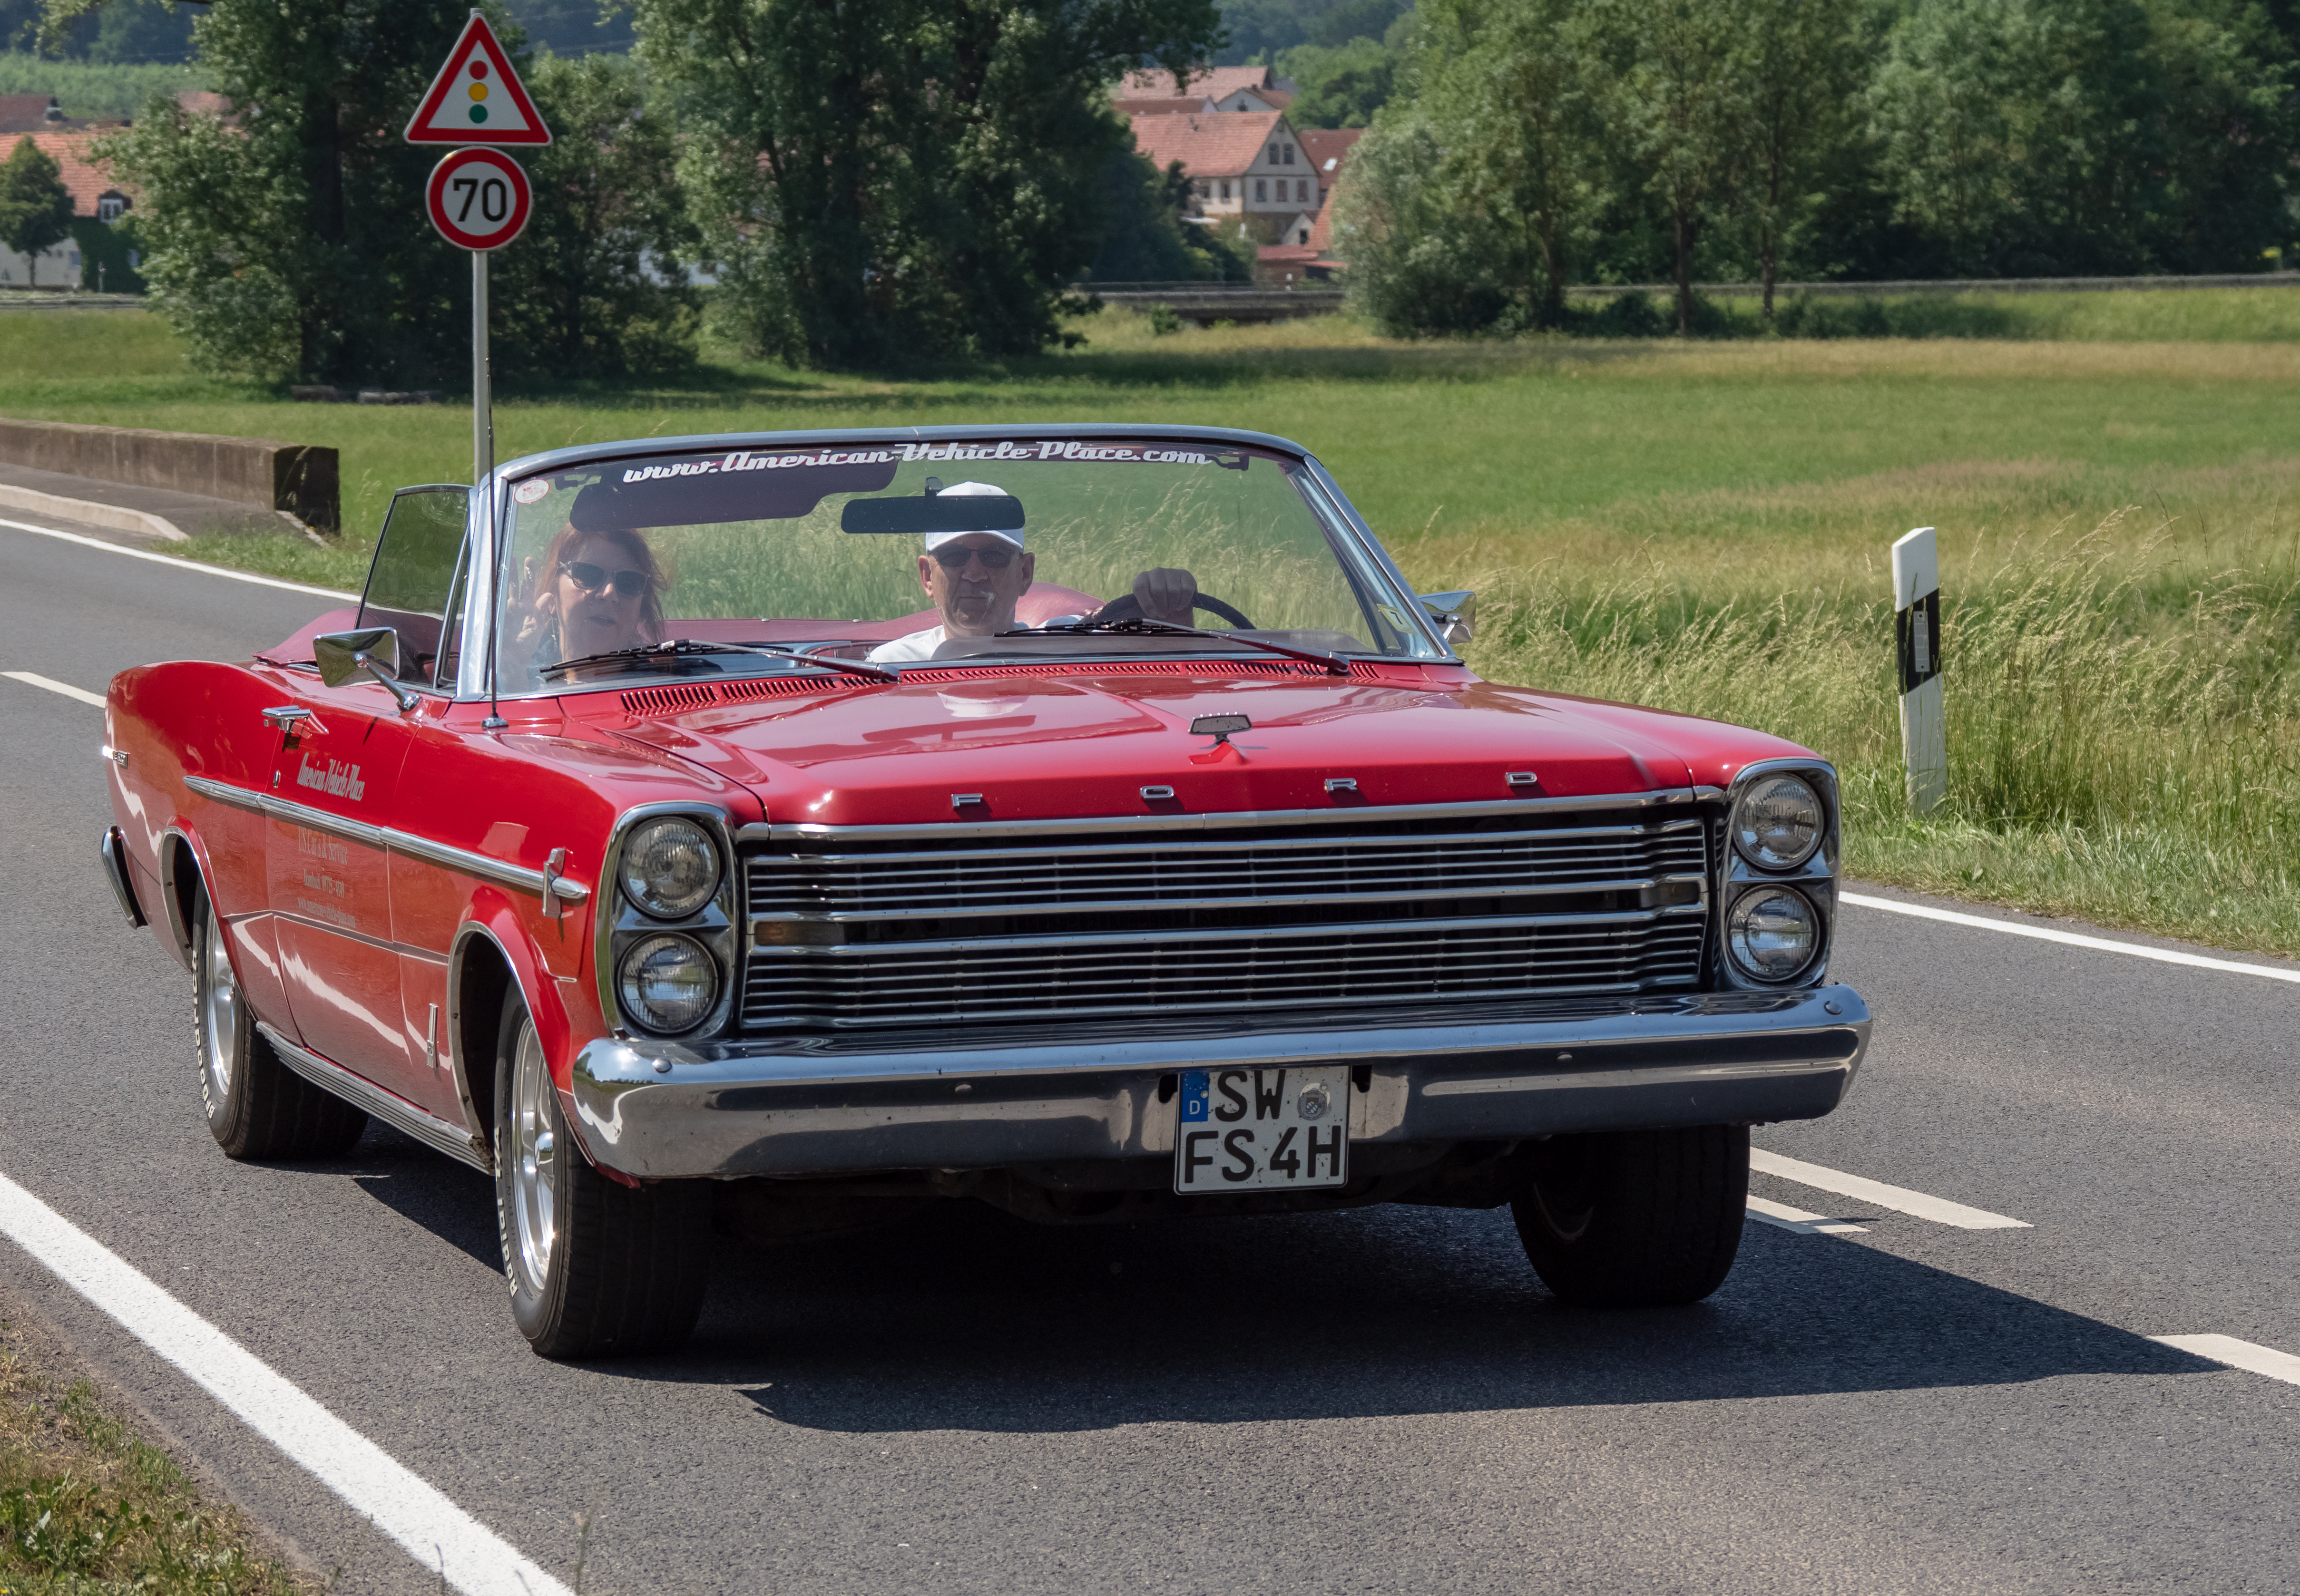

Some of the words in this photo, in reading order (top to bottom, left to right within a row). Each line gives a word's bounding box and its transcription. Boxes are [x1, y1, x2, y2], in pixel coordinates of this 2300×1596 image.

[453, 178, 507, 222] 70
[622, 441, 1213, 483] www.American-Vehicle-Place.com
[297, 752, 326, 791] American
[324, 759, 350, 797] Vehicle
[345, 764, 365, 801] Place
[951, 771, 1537, 807] FORD
[328, 834, 348, 865] Service
[192, 949, 215, 1119] BFGoodrich
[1189, 1100, 1201, 1115] D
[1215, 1069, 1286, 1122] SW
[1184, 1129, 1255, 1184] FS
[1270, 1125, 1341, 1179] 4H
[497, 1197, 519, 1297] Radial
